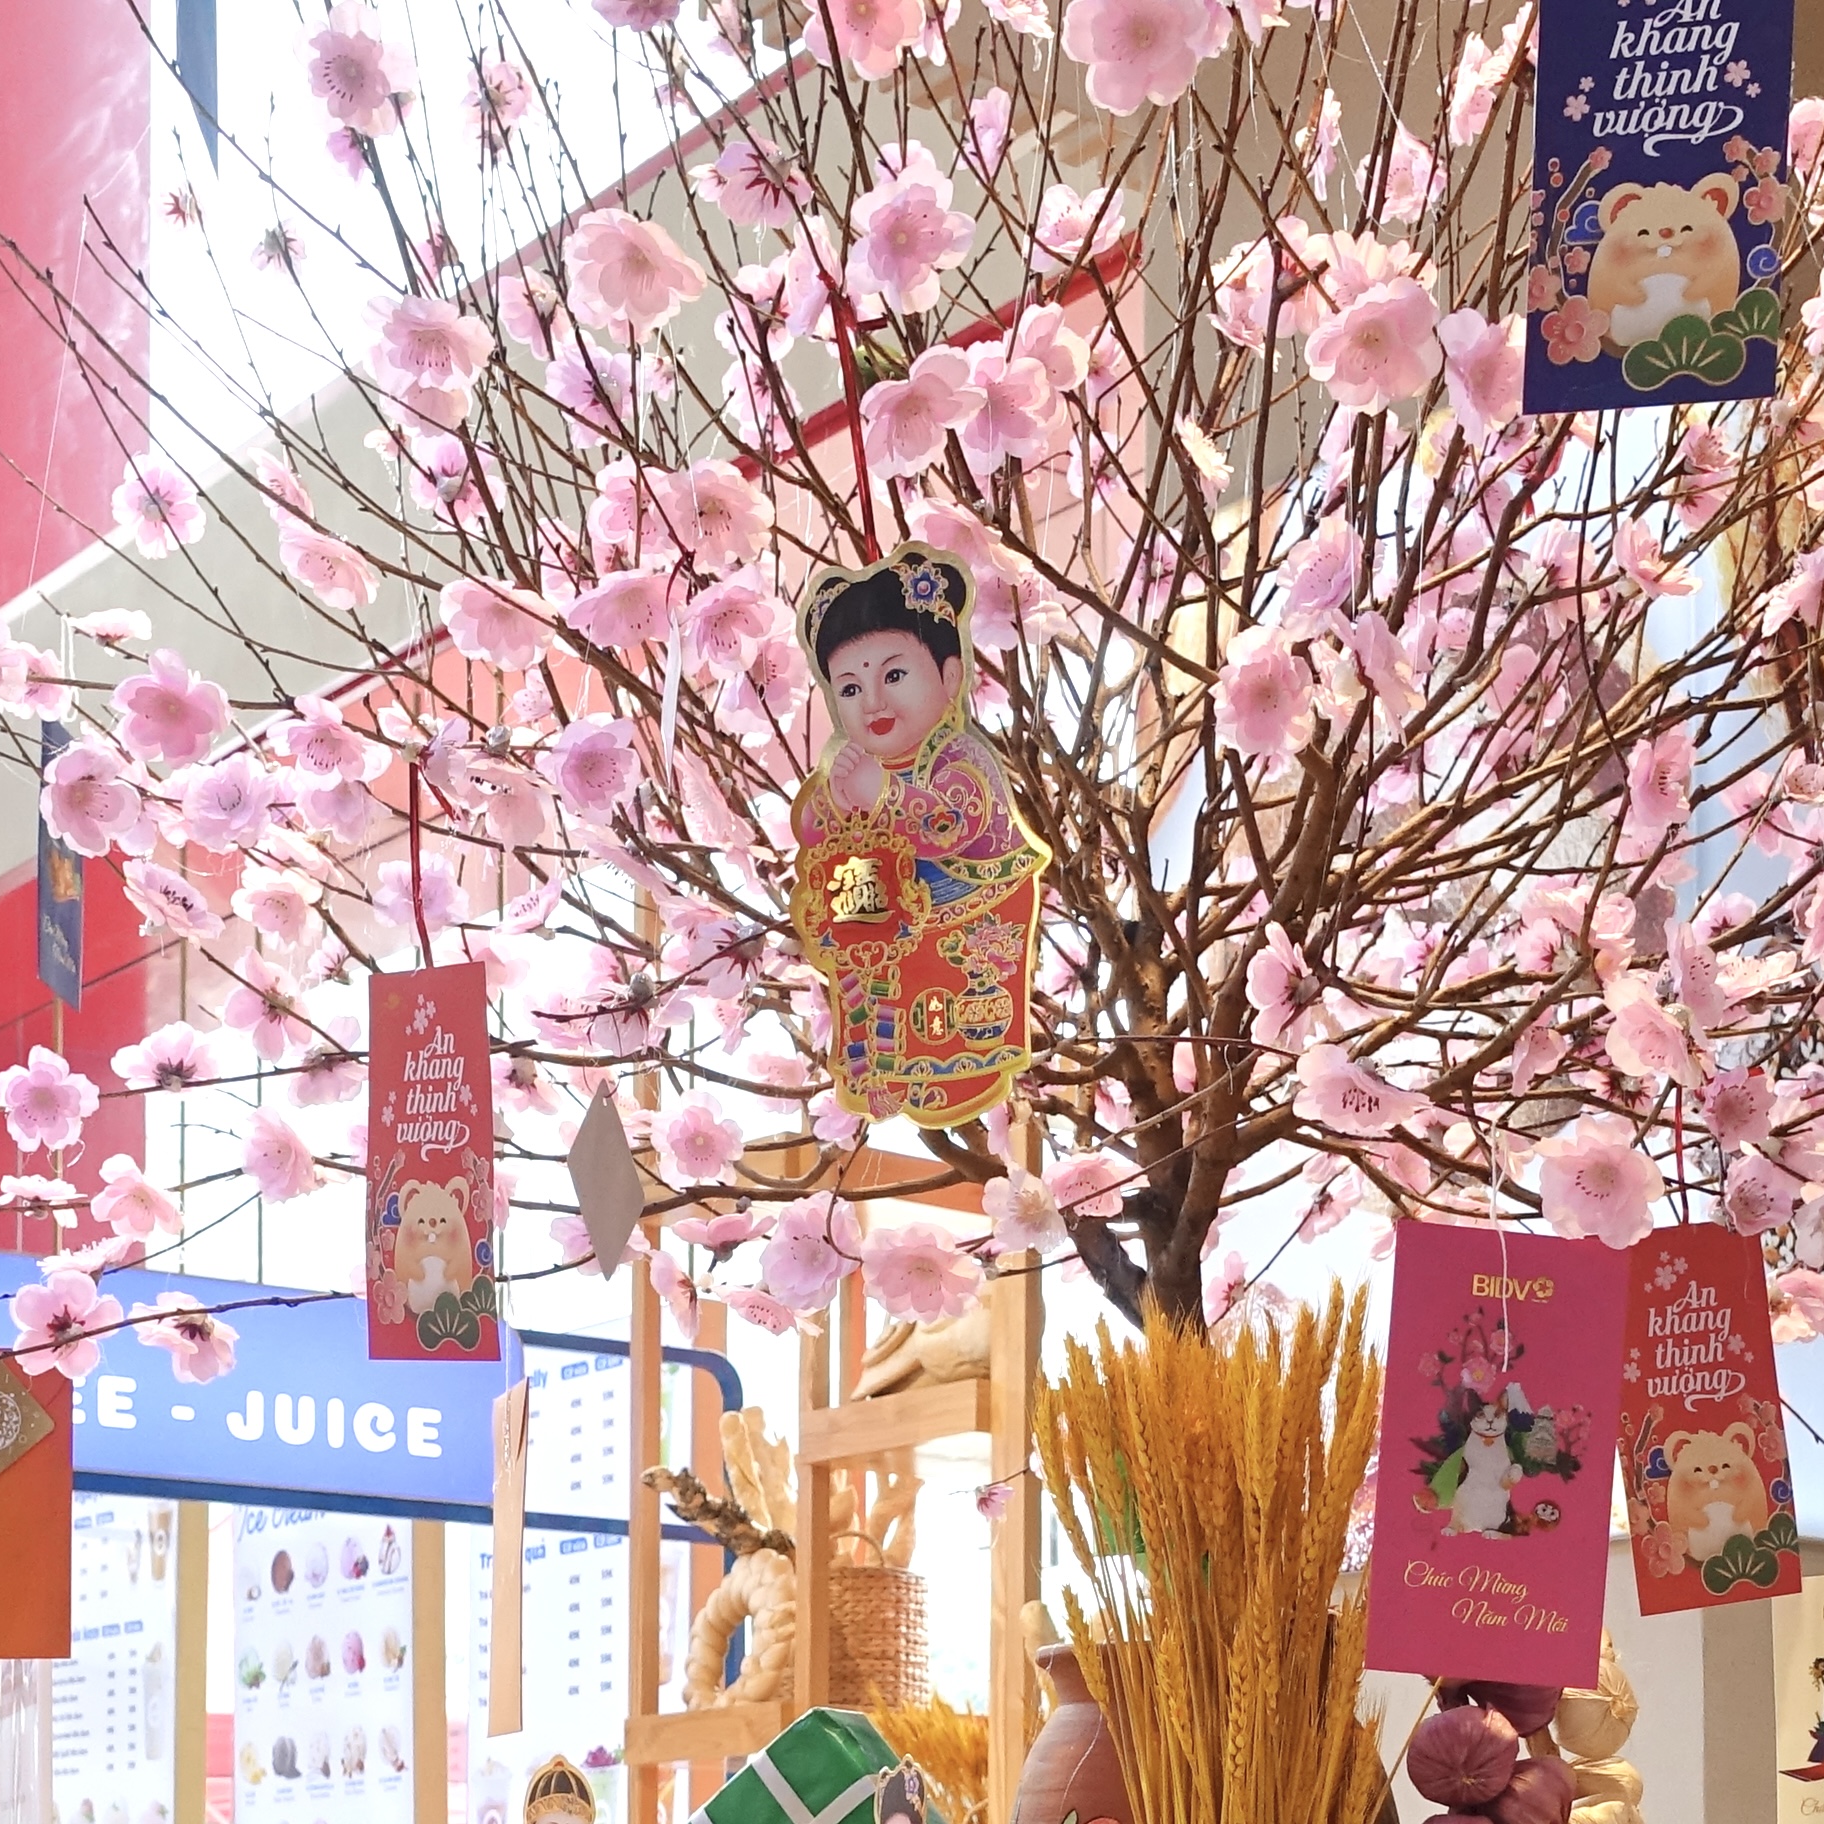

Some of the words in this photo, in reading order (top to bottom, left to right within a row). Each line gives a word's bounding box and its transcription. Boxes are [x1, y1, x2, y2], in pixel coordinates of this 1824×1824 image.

[1653, 0, 1722, 28] An
[1609, 18, 1740, 66] khang
[1592, 98, 1744, 157] vượng
[424, 1025, 456, 1058] An
[403, 1050, 465, 1091] khang
[1472, 1273, 1533, 1299] BIDV
[1673, 1280, 1718, 1313] An
[1648, 1305, 1731, 1341] khang
[1646, 1367, 1746, 1412] vượng
[226, 1390, 443, 1458] JUICE
[1402, 1559, 1453, 1589] Chúc
[1451, 1597, 1508, 1629] Năm
